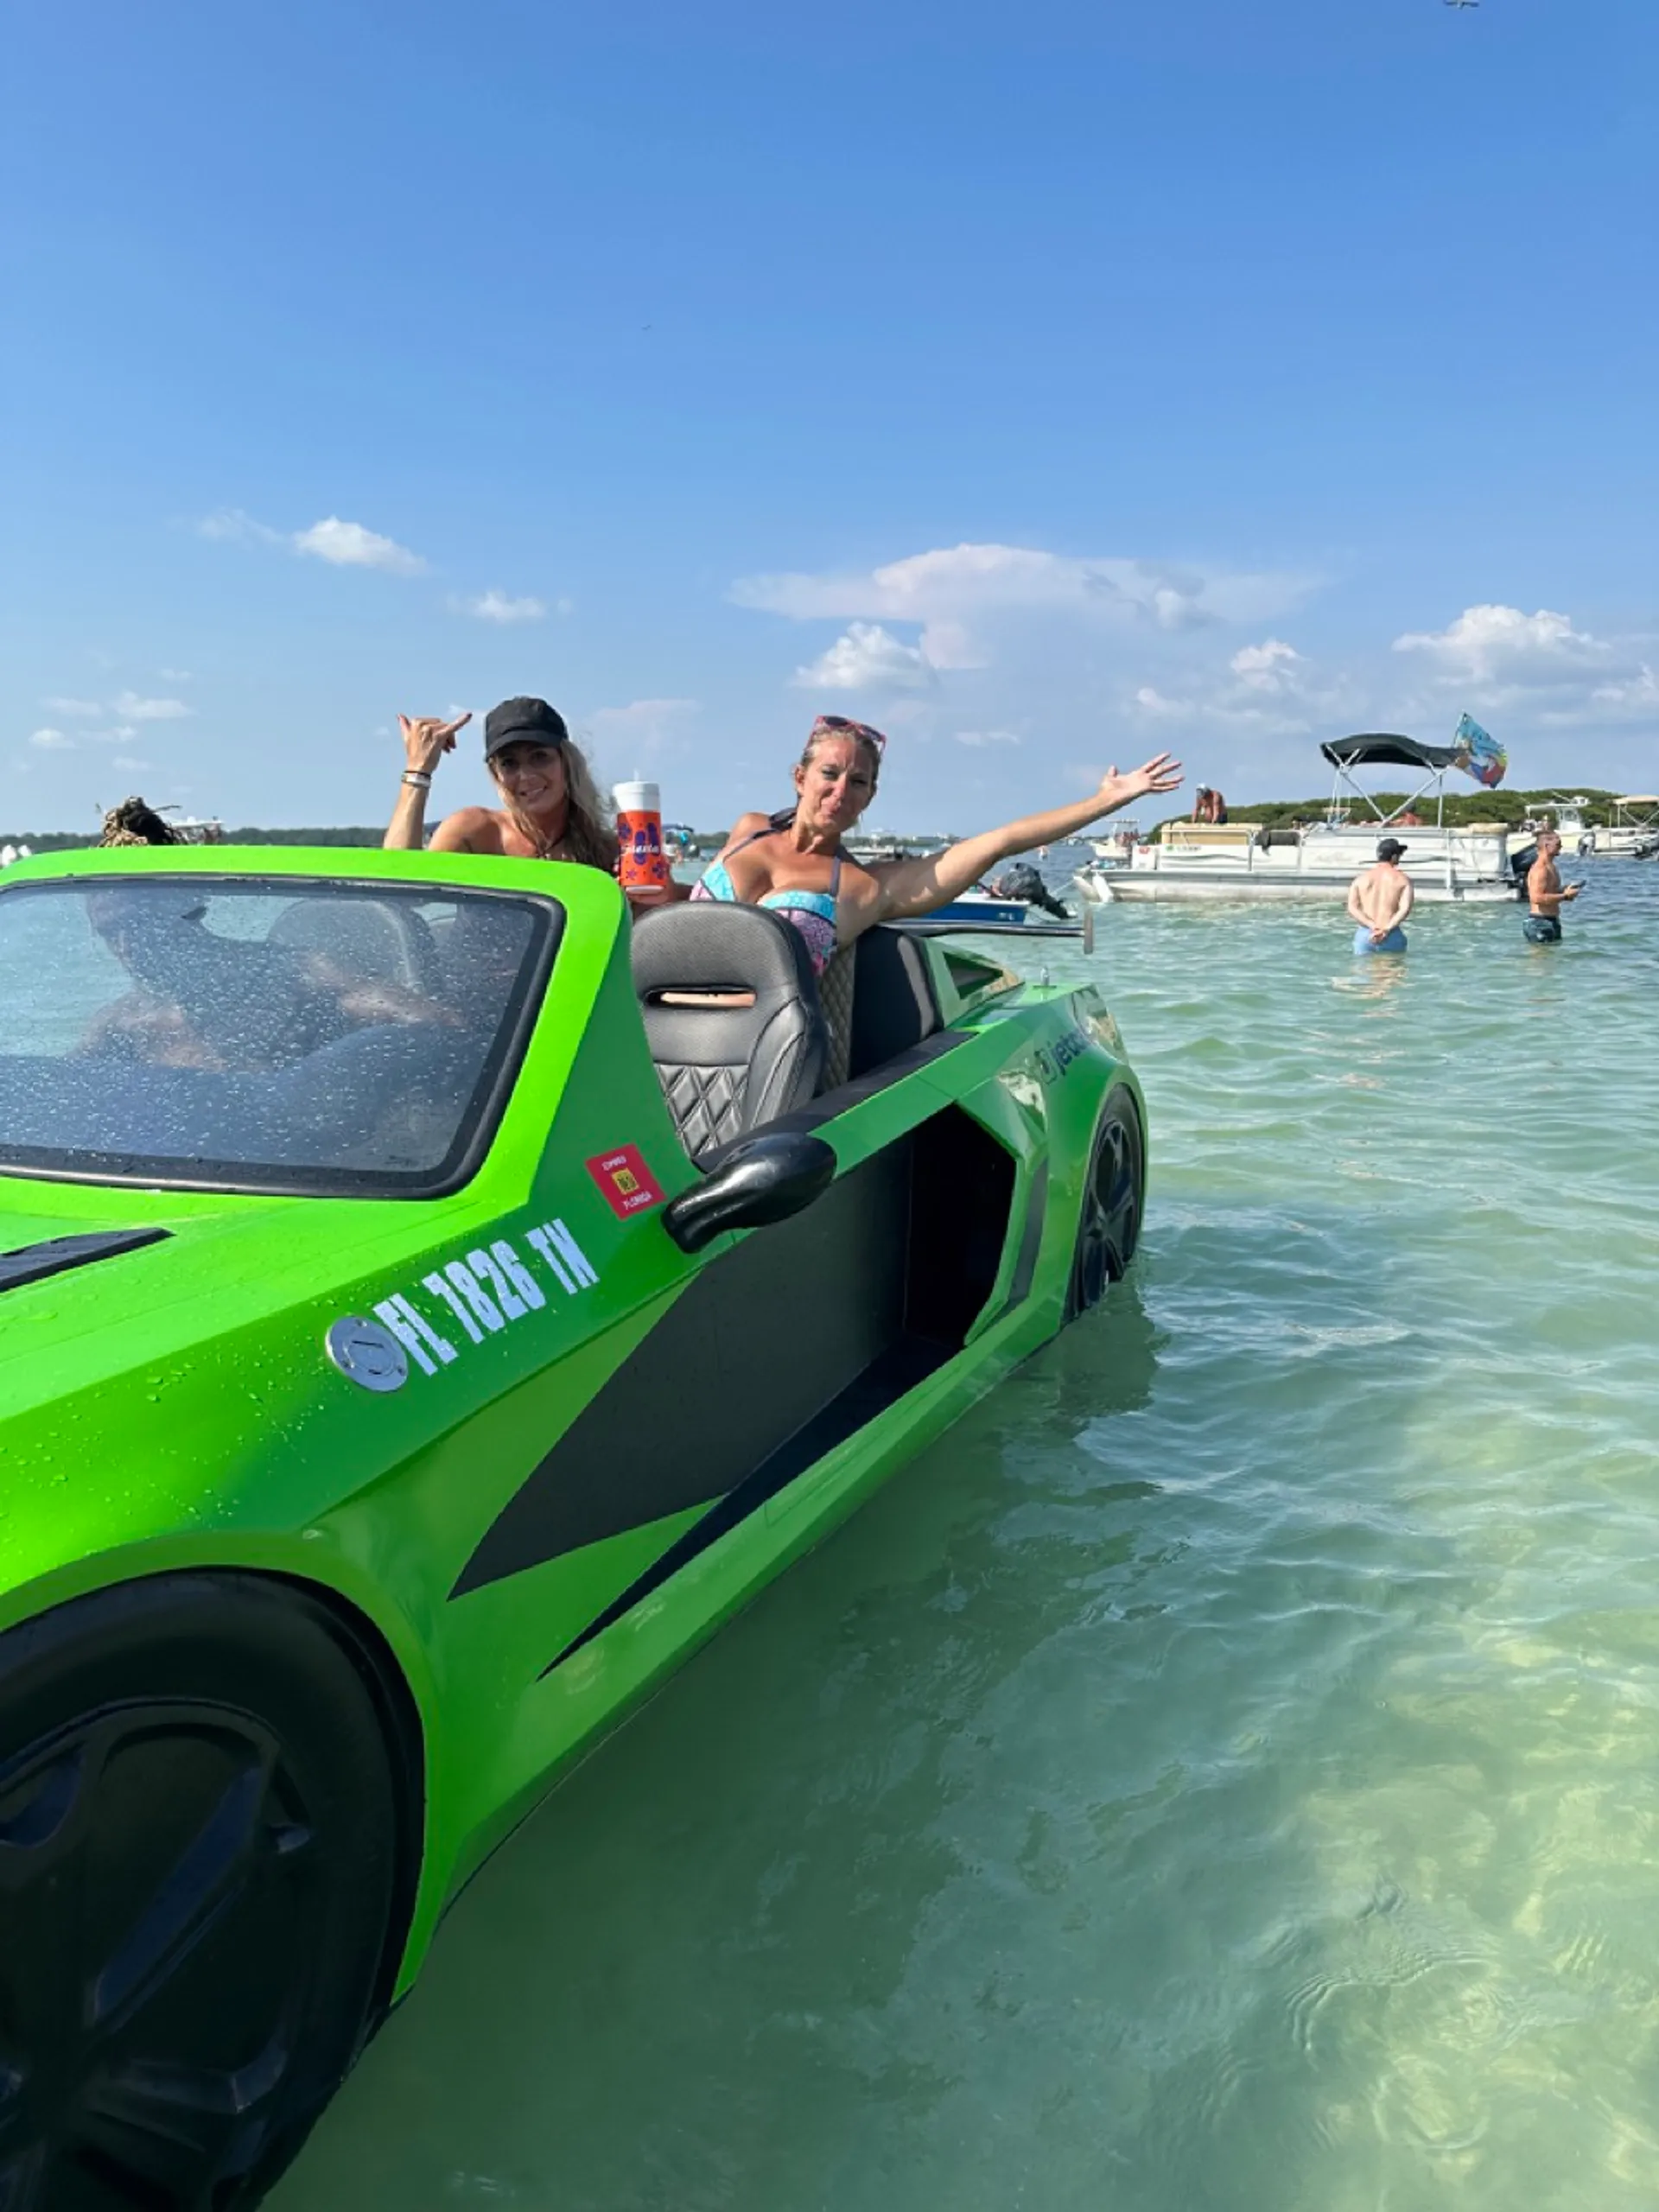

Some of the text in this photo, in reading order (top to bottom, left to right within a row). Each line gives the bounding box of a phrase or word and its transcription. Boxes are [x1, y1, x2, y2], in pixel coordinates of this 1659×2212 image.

[372, 1217, 600, 1376] FL 7826 TN
